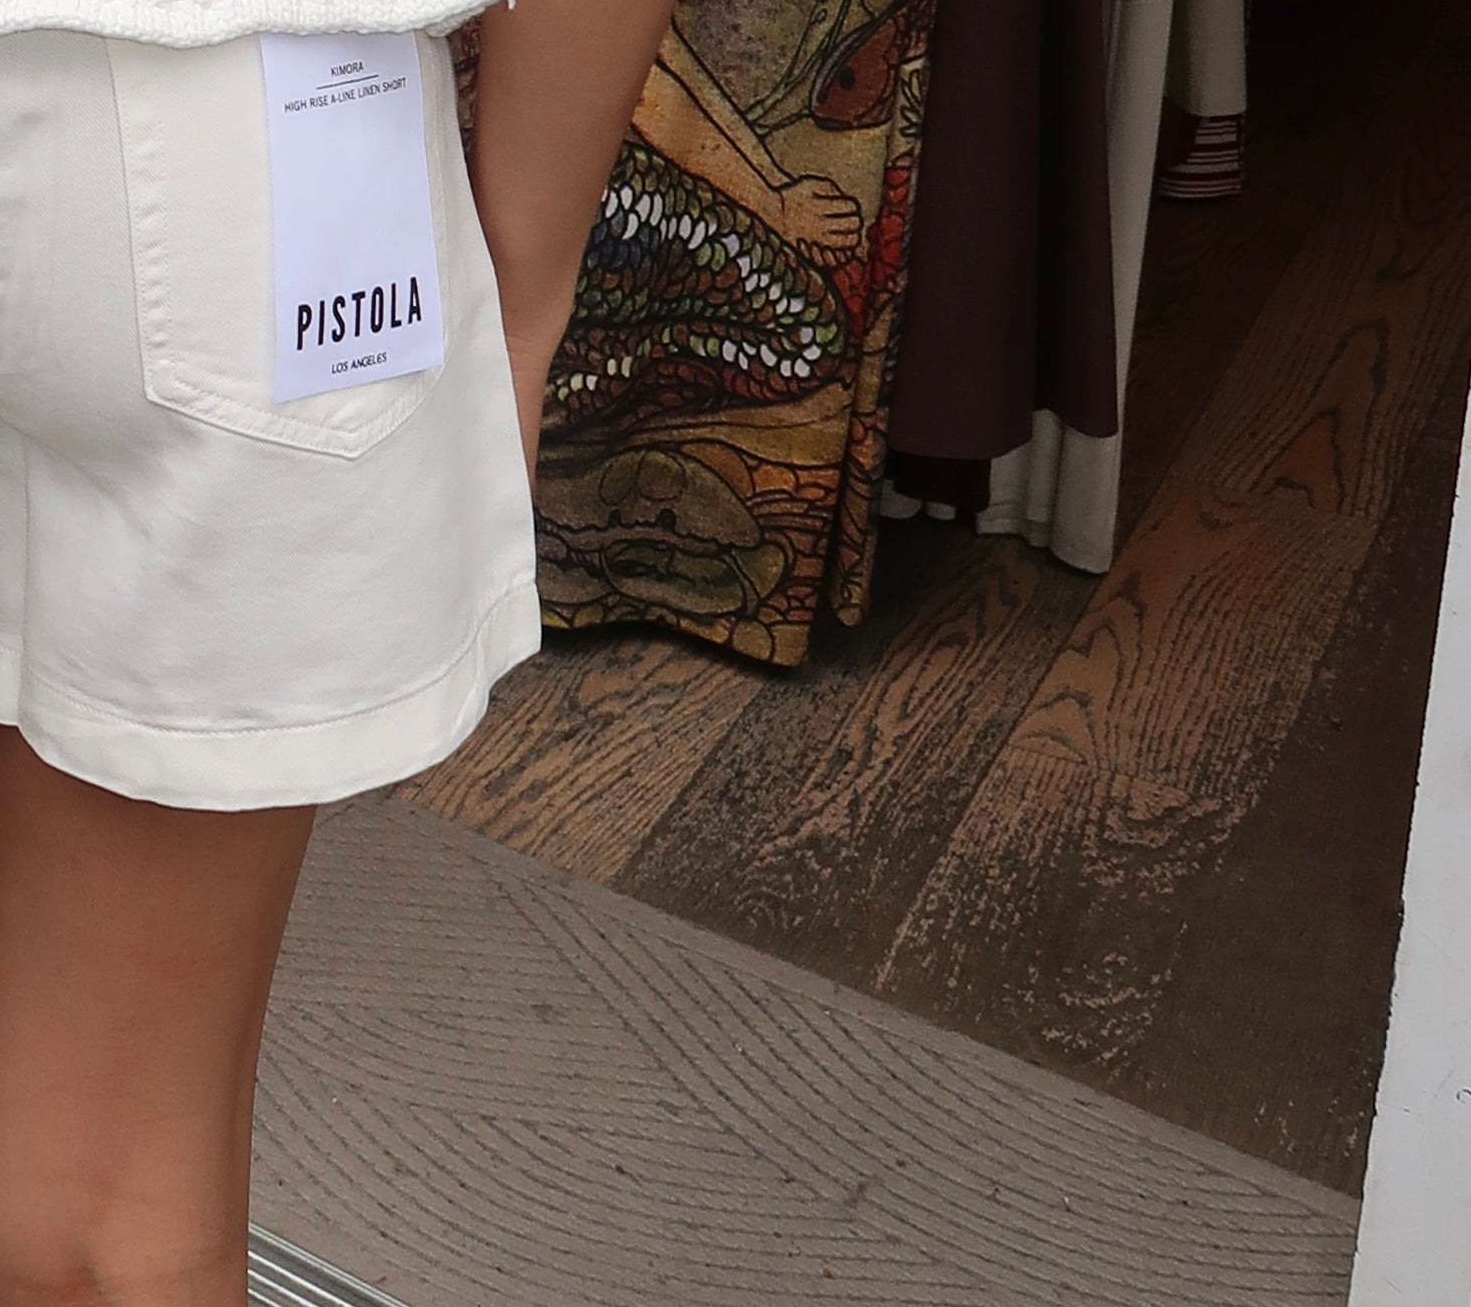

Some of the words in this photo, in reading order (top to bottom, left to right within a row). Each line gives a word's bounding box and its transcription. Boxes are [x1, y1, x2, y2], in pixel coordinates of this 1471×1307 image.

[330, 61, 364, 76] KIMORA
[284, 99, 307, 112] HIGH
[309, 94, 328, 108] RISE
[330, 89, 356, 104] A-LINE
[358, 84, 381, 98] LINEN
[382, 77, 406, 93] SHORT
[297, 276, 422, 351] PISTOLA
[331, 361, 349, 375] LOS
[350, 352, 388, 370] ANGELES
